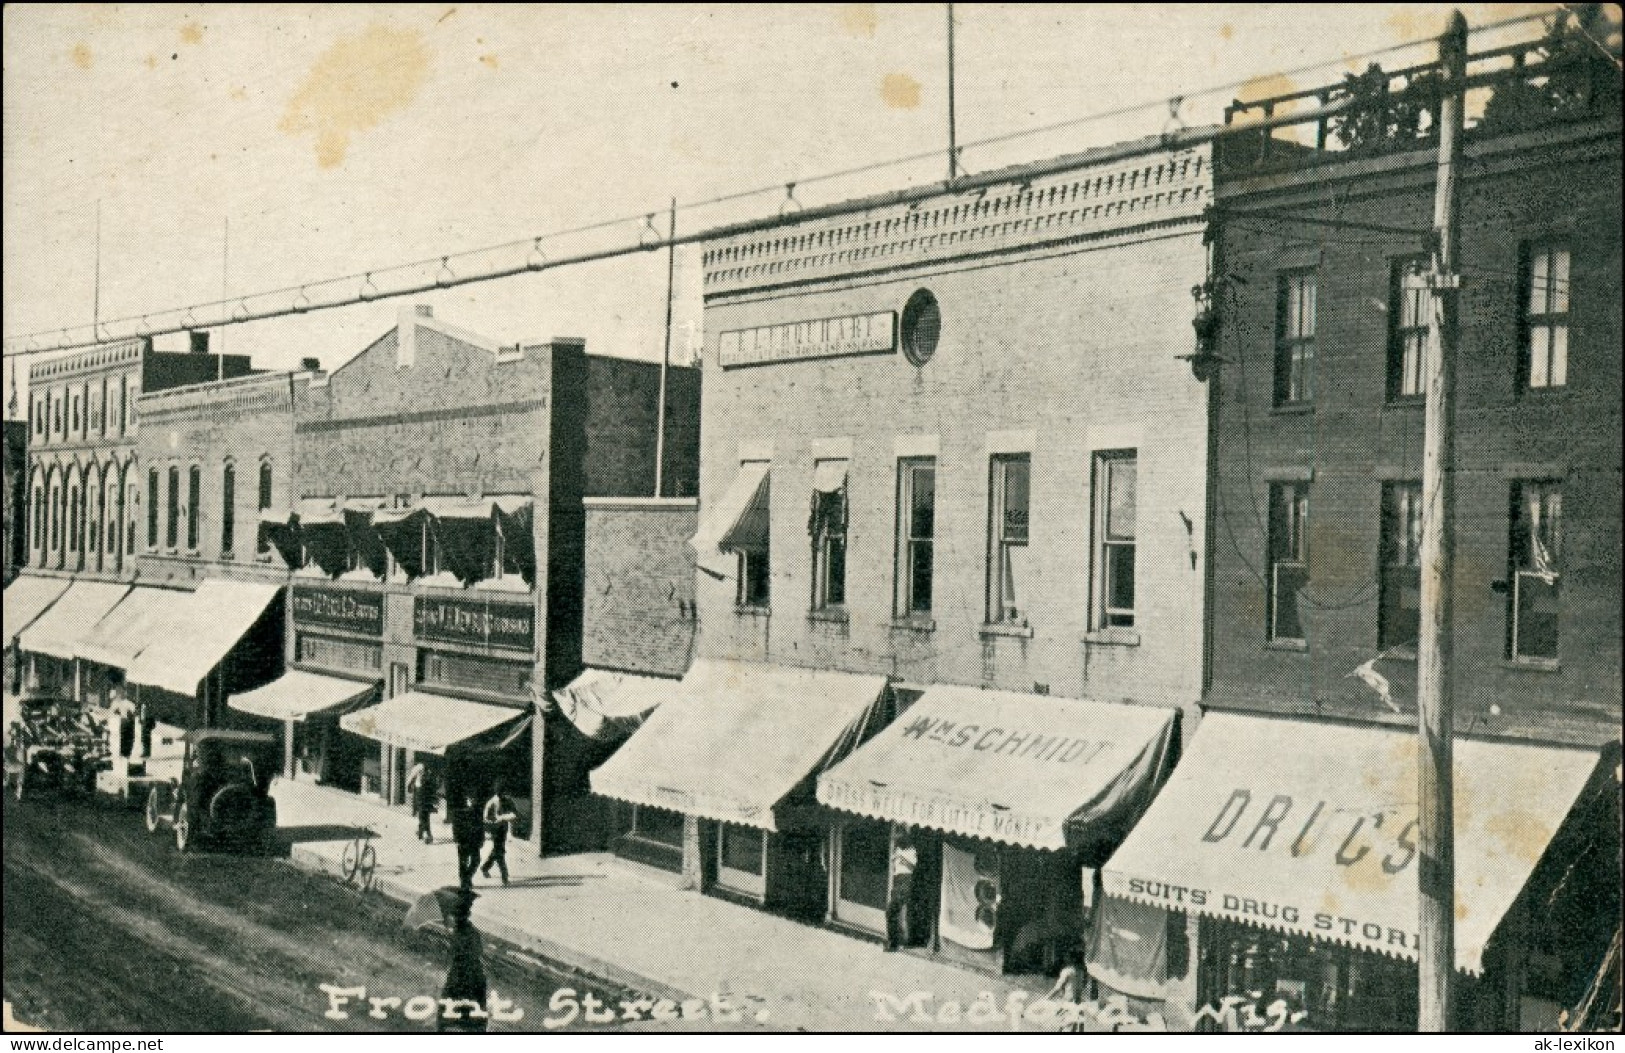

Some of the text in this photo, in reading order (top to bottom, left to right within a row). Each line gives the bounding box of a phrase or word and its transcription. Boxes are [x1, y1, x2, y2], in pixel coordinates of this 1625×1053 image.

[949, 725, 1115, 764] SCHMIDT
[827, 782, 866, 808] DRESS
[871, 791, 905, 816] WELL
[911, 799, 934, 822] FOR
[941, 805, 985, 831] LITTLE
[1201, 788, 1420, 875] DRUGS
[1223, 894, 1300, 924] DRUG
